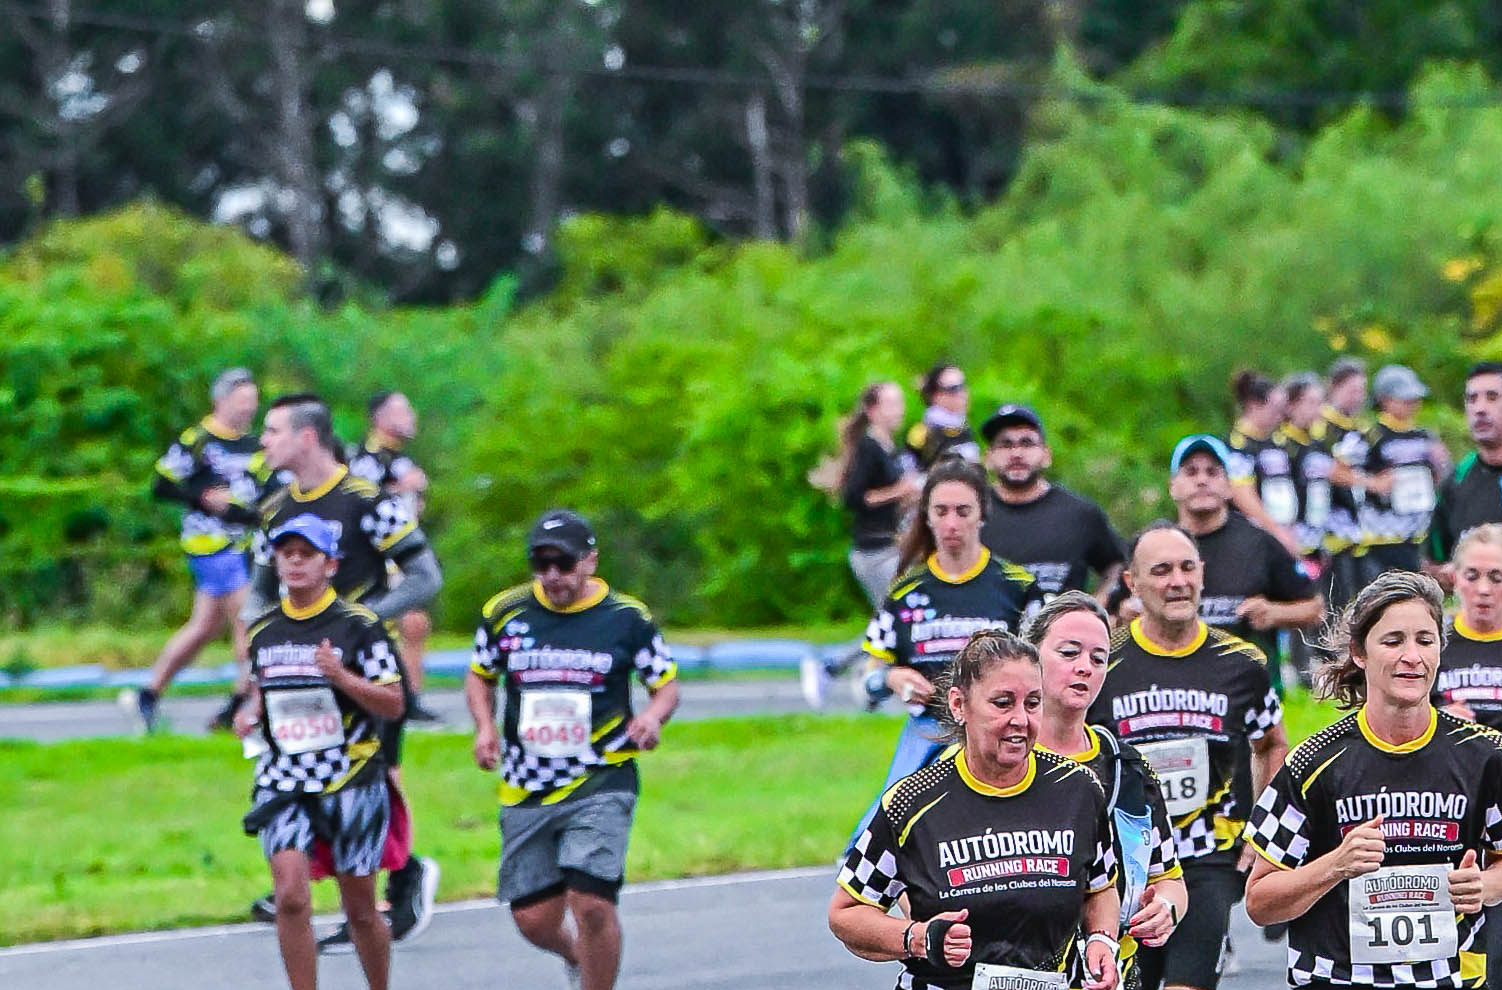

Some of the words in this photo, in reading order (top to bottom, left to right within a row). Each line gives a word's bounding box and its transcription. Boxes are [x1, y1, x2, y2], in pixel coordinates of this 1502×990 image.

[1112, 683, 1228, 720] AUTÓDROMO
[525, 723, 585, 745] 4049
[1336, 786, 1468, 823] AUTÓDROMO
[1380, 822, 1410, 837] NING
[1414, 822, 1447, 839] RACE
[938, 828, 1075, 868] AUTÓDROMO
[1394, 844, 1421, 853] Clubes
[1422, 843, 1435, 852] del
[962, 859, 1023, 882] RUNNING
[1025, 858, 1059, 874] RACE
[939, 891, 949, 899] La
[949, 887, 981, 897] Carrera
[982, 884, 994, 893] de
[995, 883, 1007, 891] los
[1009, 879, 1037, 889] Clubes
[1038, 878, 1051, 887] del
[1364, 872, 1440, 894] AUTÓDROMO
[1368, 914, 1439, 947] 101
